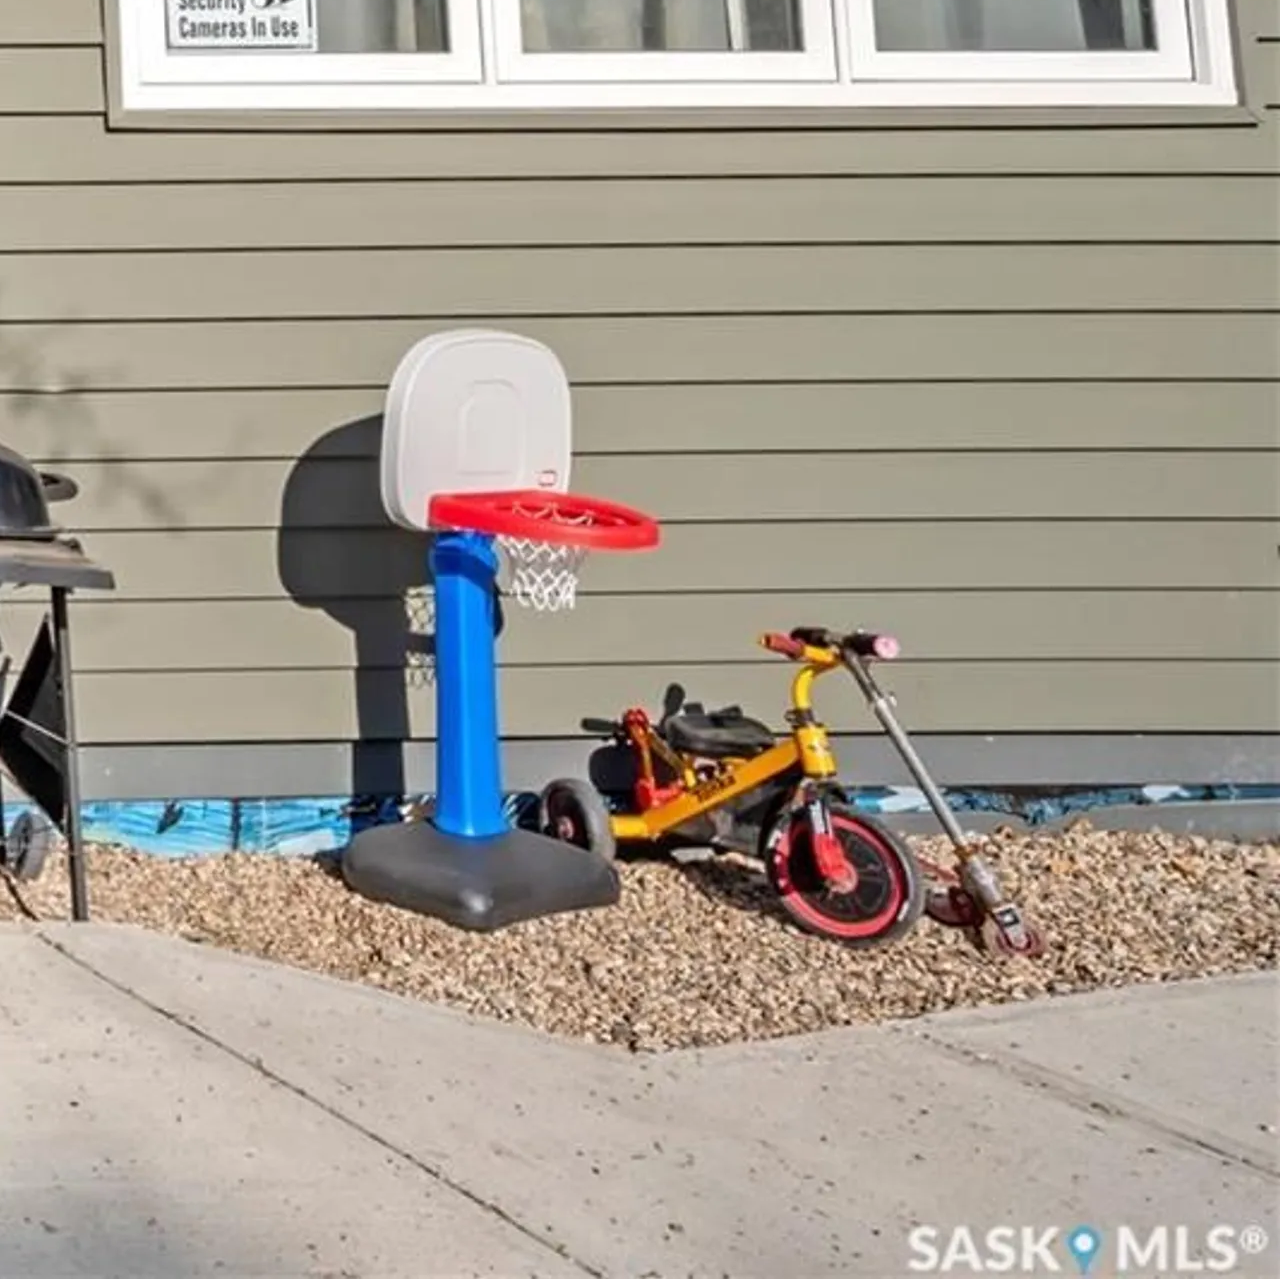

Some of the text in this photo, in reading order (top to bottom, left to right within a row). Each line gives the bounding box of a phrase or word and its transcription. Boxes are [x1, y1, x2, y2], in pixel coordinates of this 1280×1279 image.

[178, 16, 299, 39] Cameras In Use
